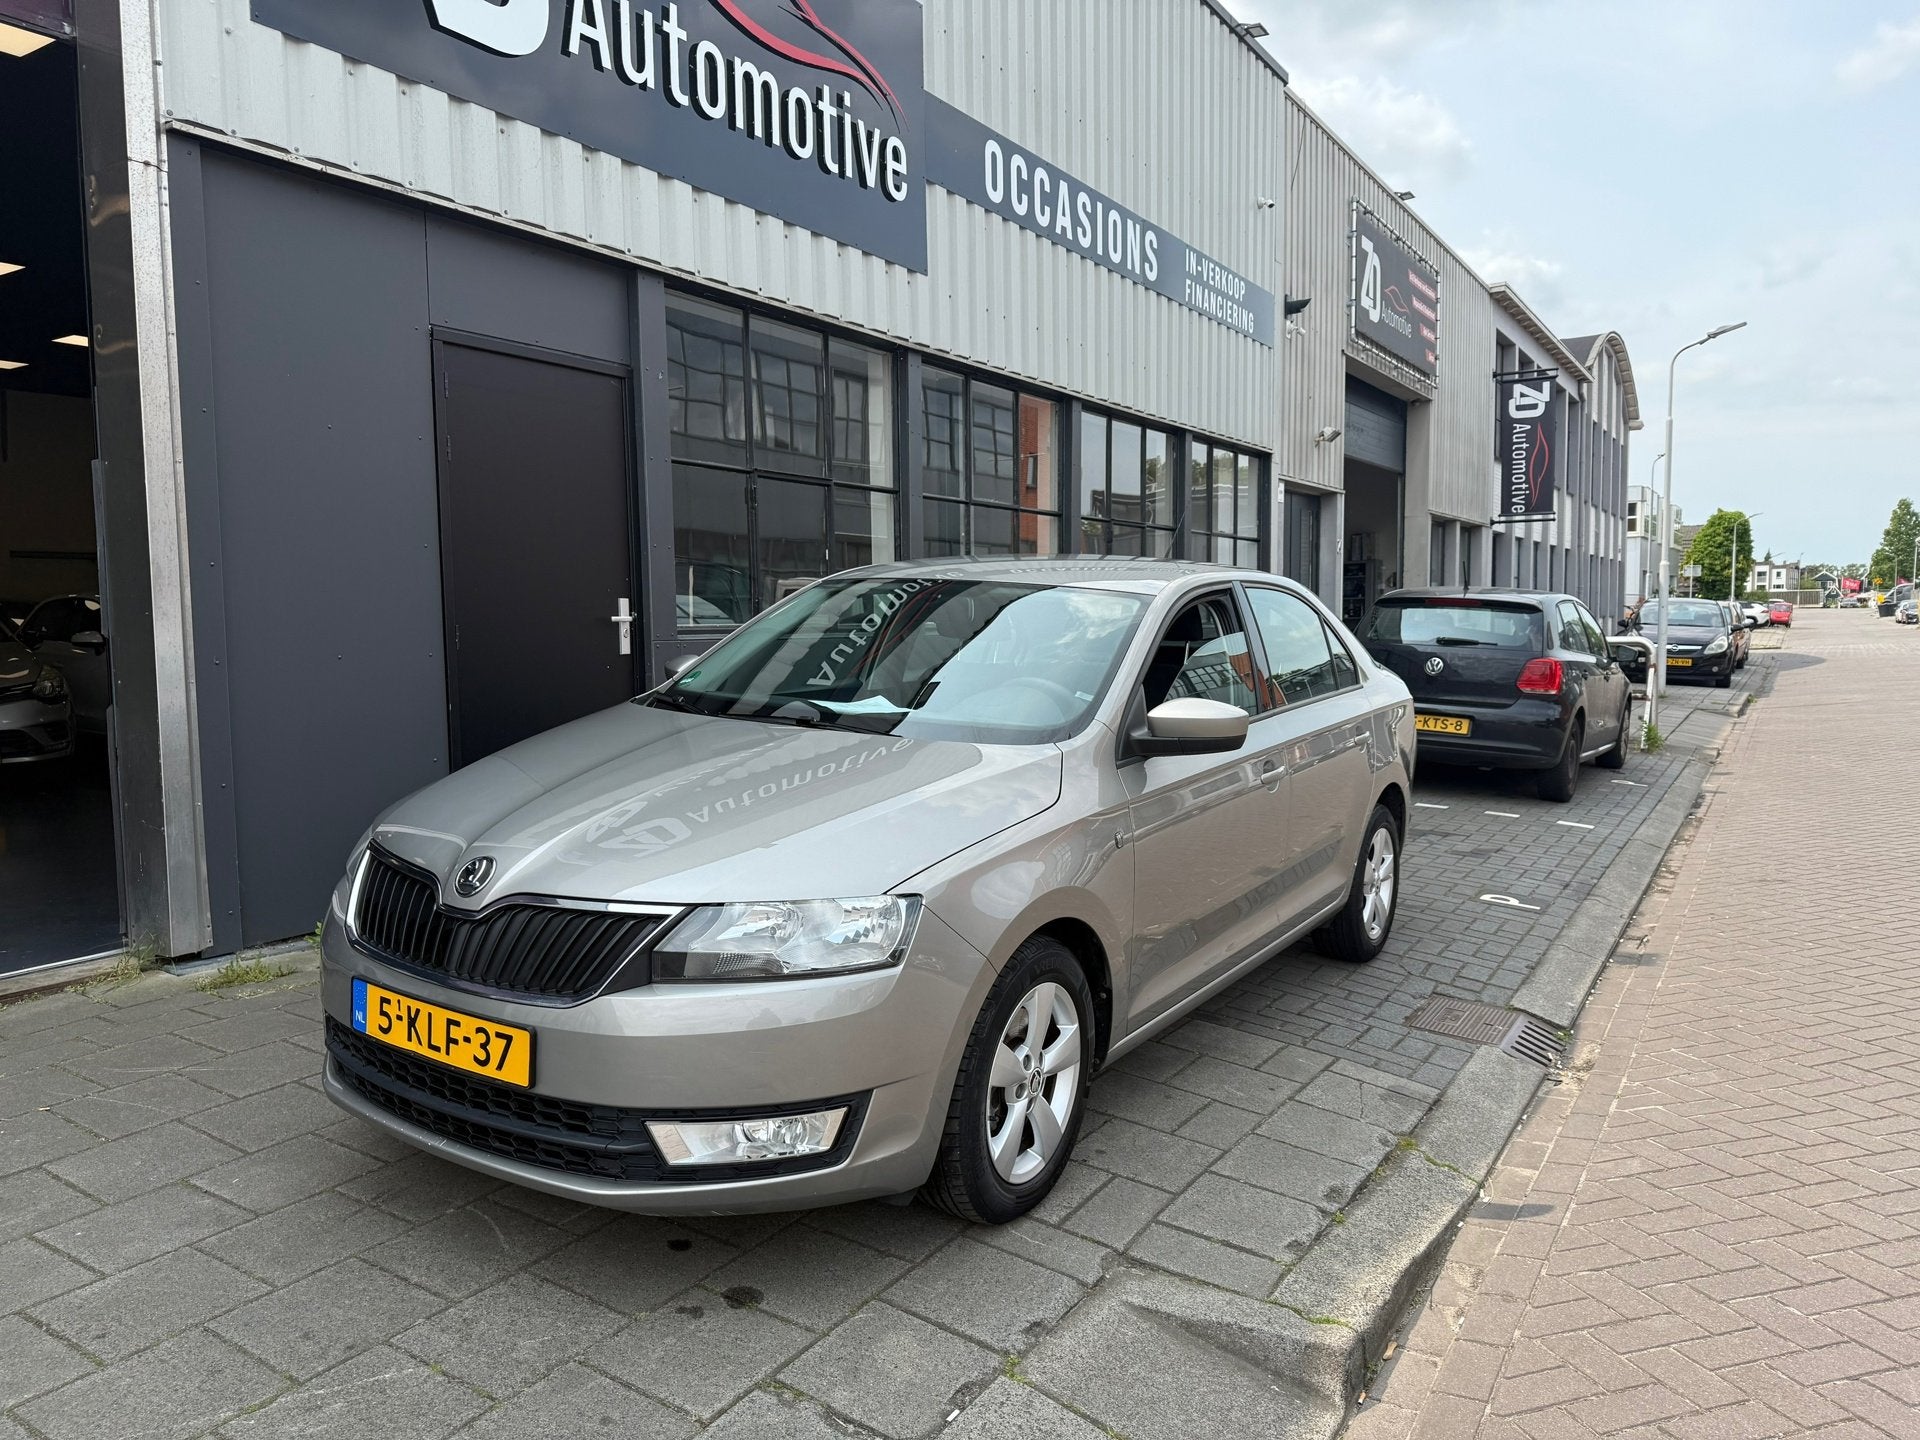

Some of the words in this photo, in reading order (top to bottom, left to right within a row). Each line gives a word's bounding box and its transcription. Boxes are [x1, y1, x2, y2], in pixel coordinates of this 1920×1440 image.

[568, 0, 907, 201] Automotive
[985, 140, 1158, 281] OCCASIONS
[1185, 249, 1245, 301] IN-VERKOOP
[1185, 279, 1254, 334] FINANCIERING
[1382, 301, 1412, 338] Automotive
[1511, 423, 1532, 513] Automotive
[355, 1010, 365, 1024] NL
[378, 996, 513, 1072] 5-KLF-37
